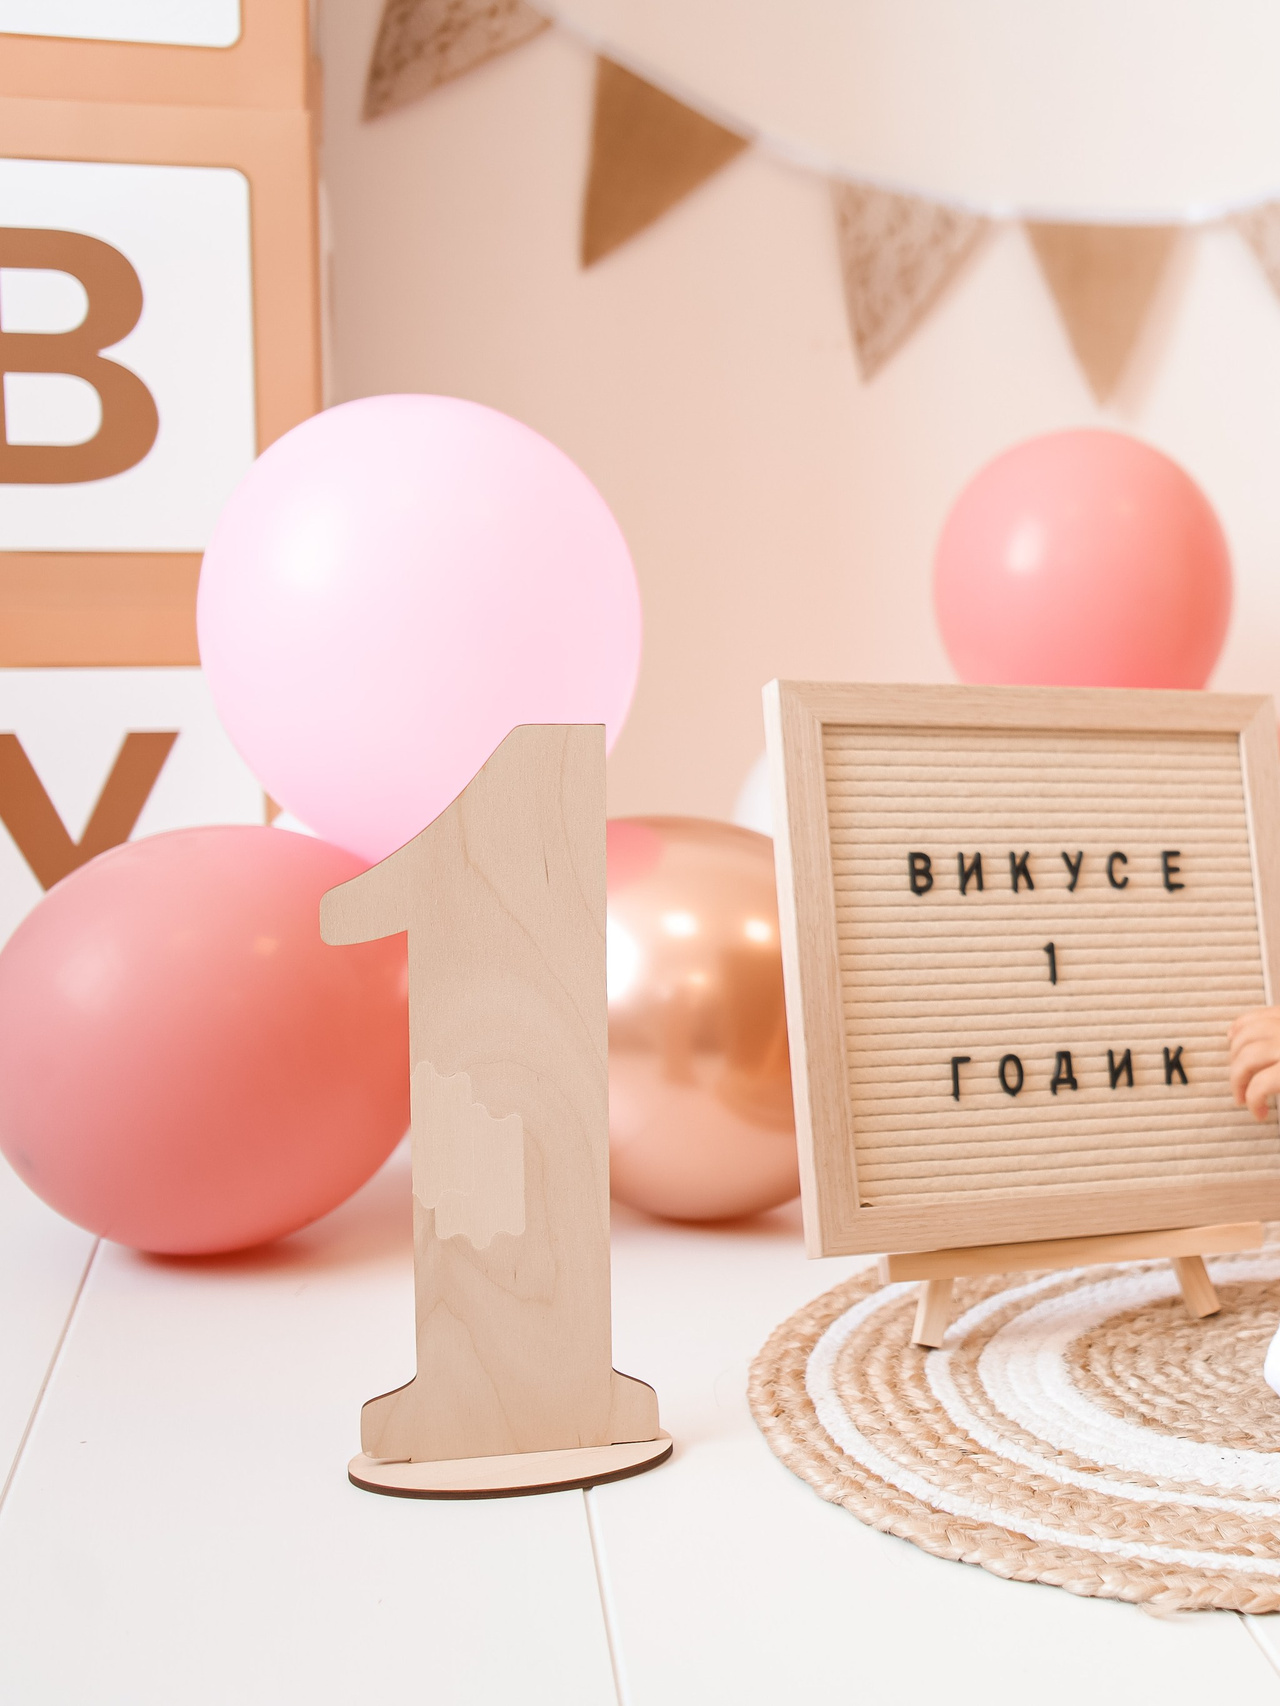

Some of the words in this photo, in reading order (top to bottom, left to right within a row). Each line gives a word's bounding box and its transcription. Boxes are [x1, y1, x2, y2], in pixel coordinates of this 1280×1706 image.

[0, 227, 160, 487] B
[908, 849, 1186, 896] ВИКУСЕ
[1042, 941, 1058, 986] 1
[319, 723, 660, 1461] 1
[949, 1045, 1189, 1102] ГОДИК
